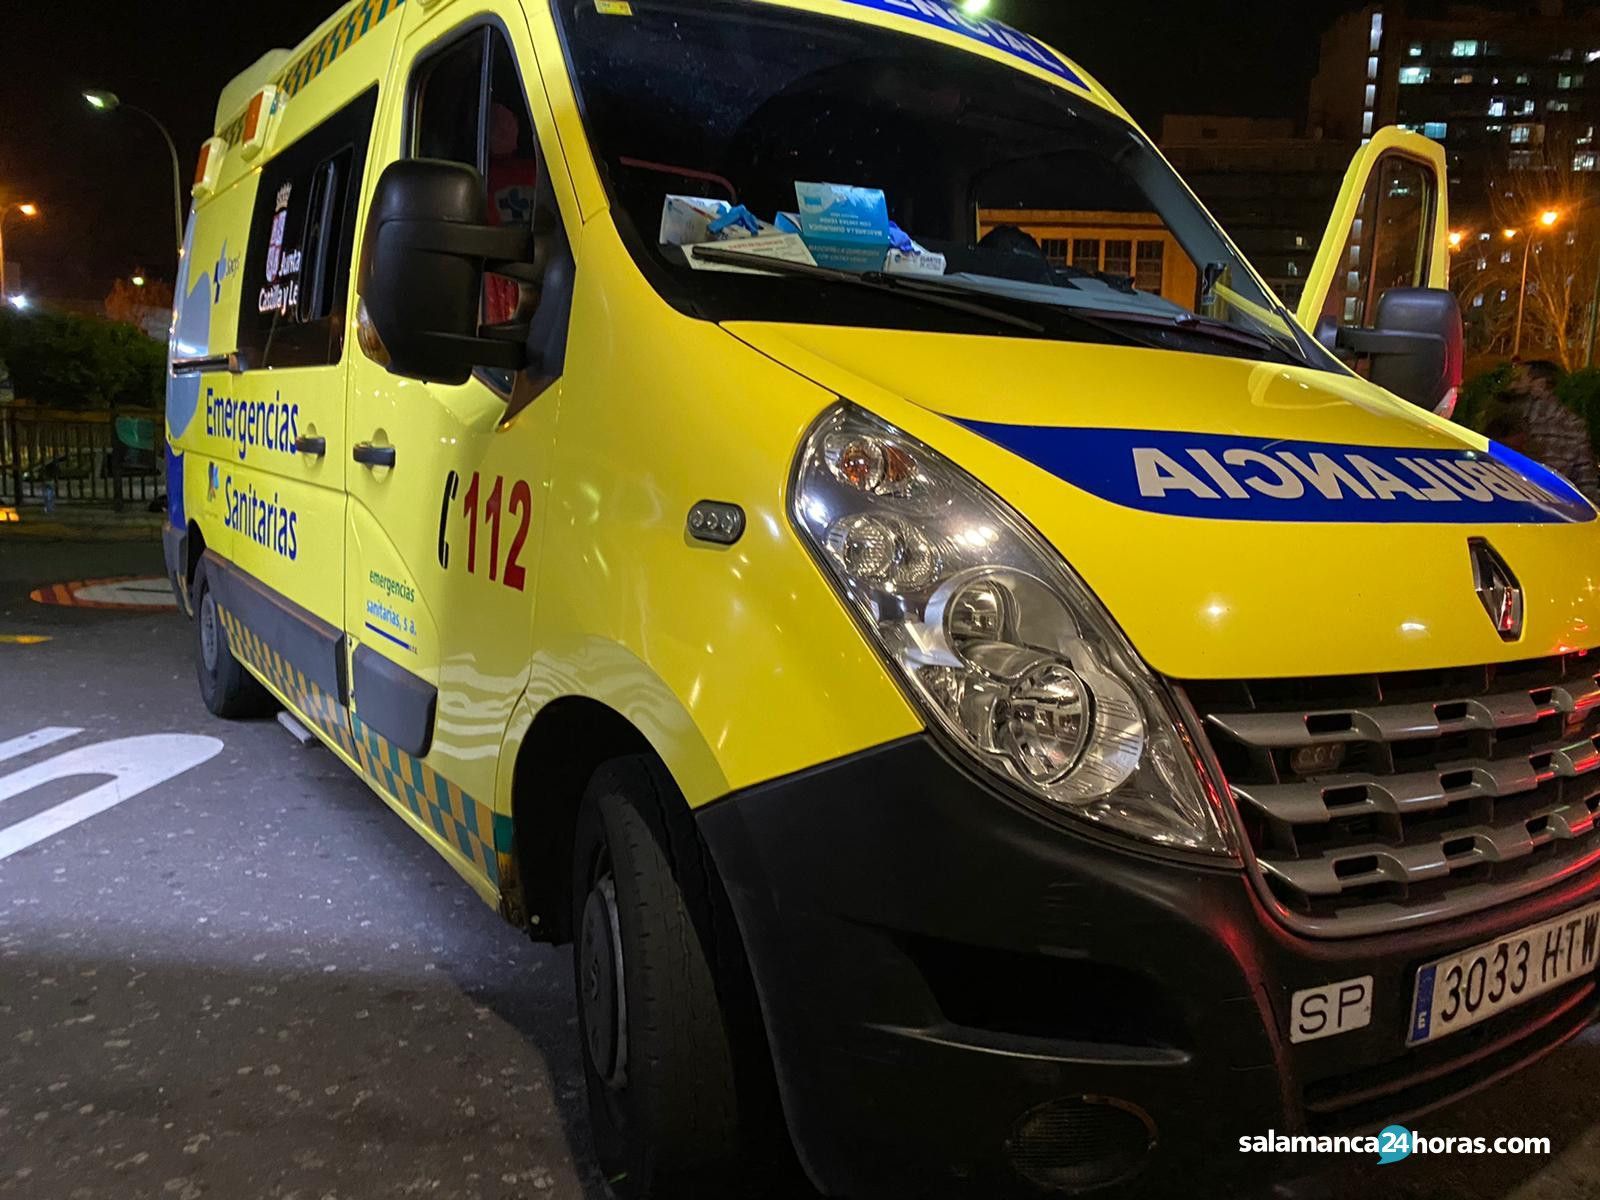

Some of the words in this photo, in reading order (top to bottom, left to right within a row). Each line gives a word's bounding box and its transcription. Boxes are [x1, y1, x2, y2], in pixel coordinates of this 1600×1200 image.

[206, 388, 299, 460] Emergencias
[224, 475, 298, 561] Sanitarias
[464, 471, 532, 592] 112
[369, 569, 415, 603] emergencias
[1441, 942, 1530, 1023] 3033
[1541, 911, 1600, 983] HTW
[1299, 983, 1366, 1035] SP
[1417, 1011, 1427, 1030] E
